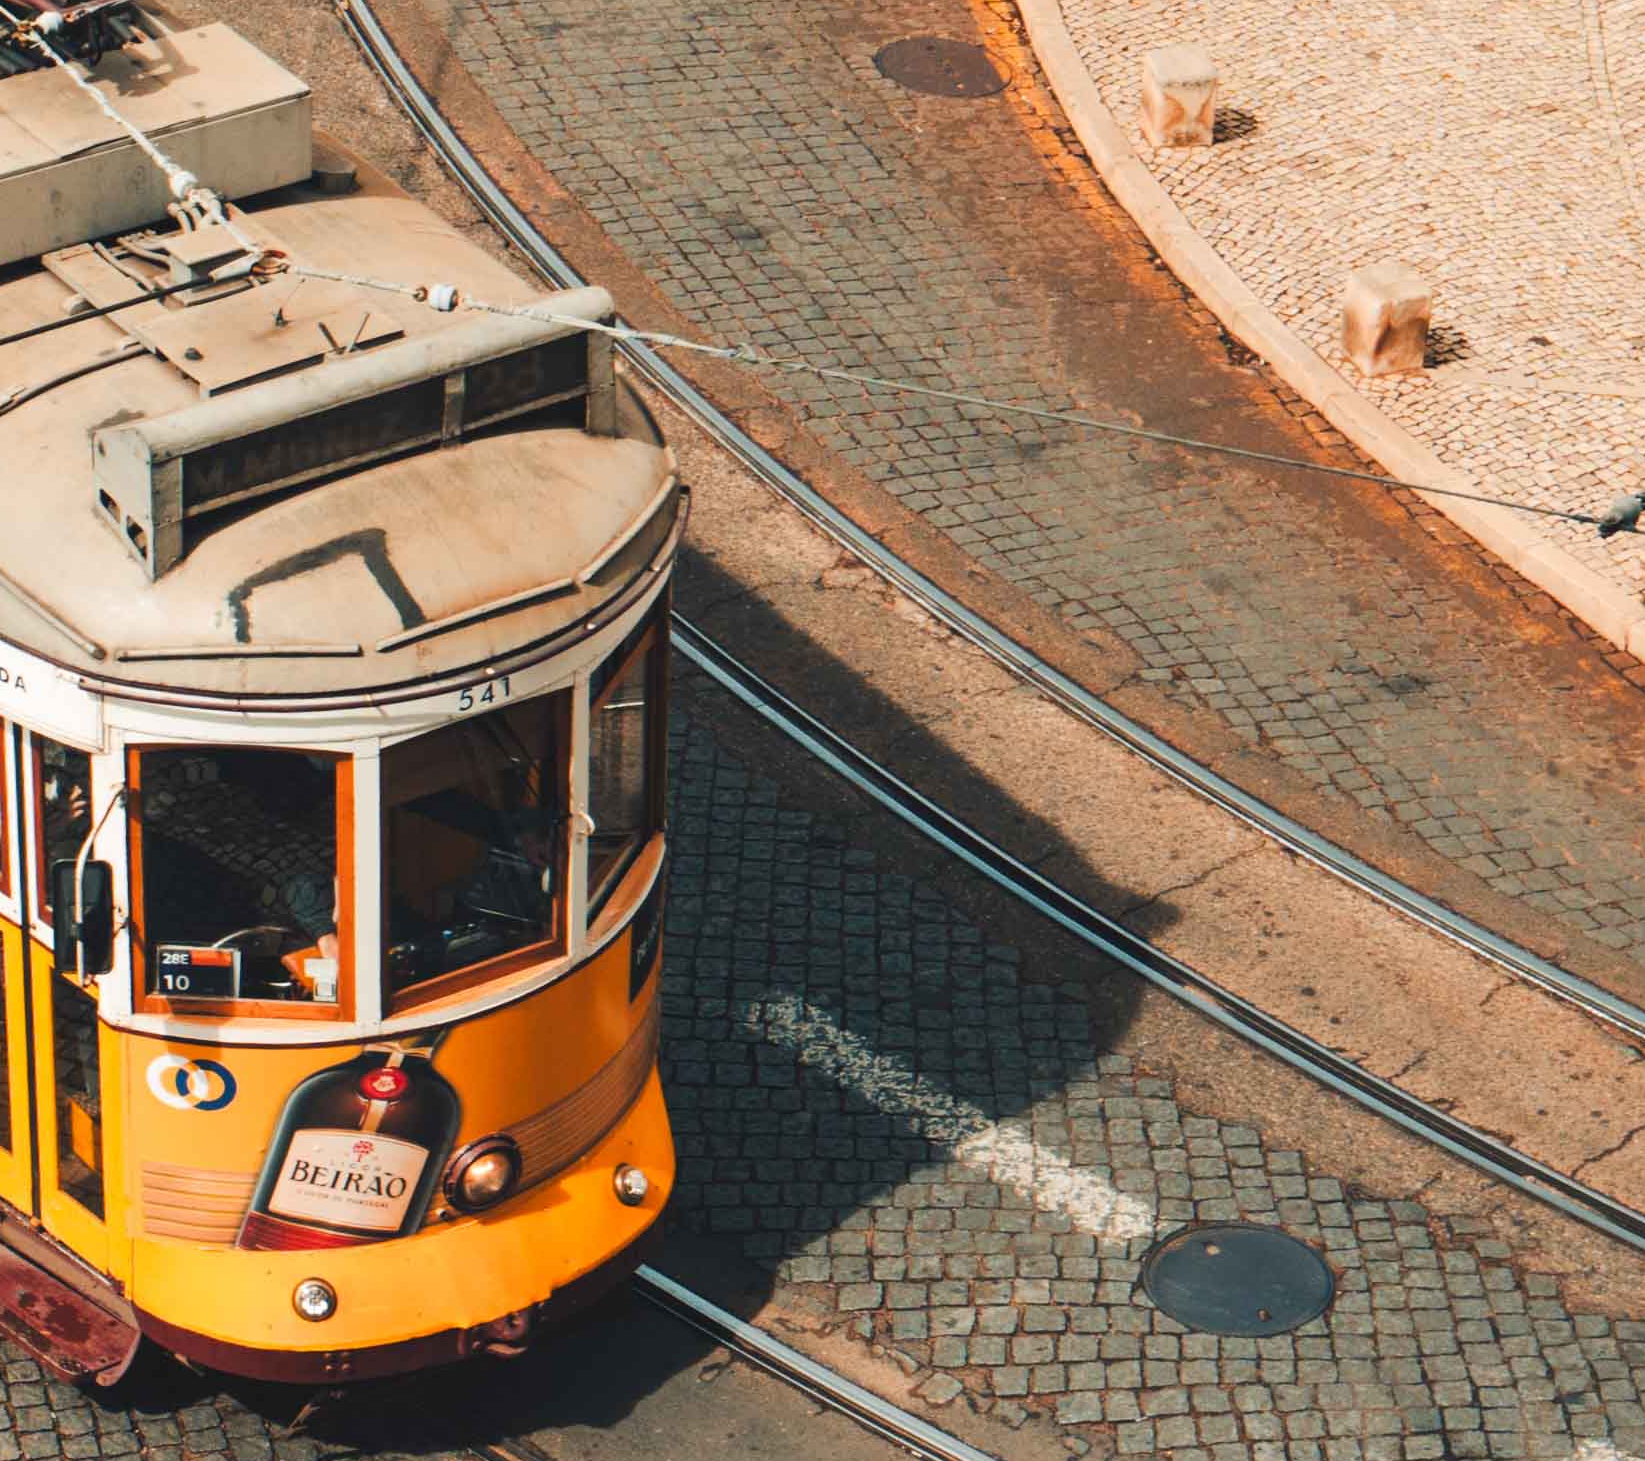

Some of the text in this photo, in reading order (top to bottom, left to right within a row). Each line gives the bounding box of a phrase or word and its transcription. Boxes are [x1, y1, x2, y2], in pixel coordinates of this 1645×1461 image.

[458, 676, 510, 711] 541
[161, 952, 191, 966] 28E
[163, 974, 191, 992] 10
[289, 1158, 408, 1199] BEIRÃO
